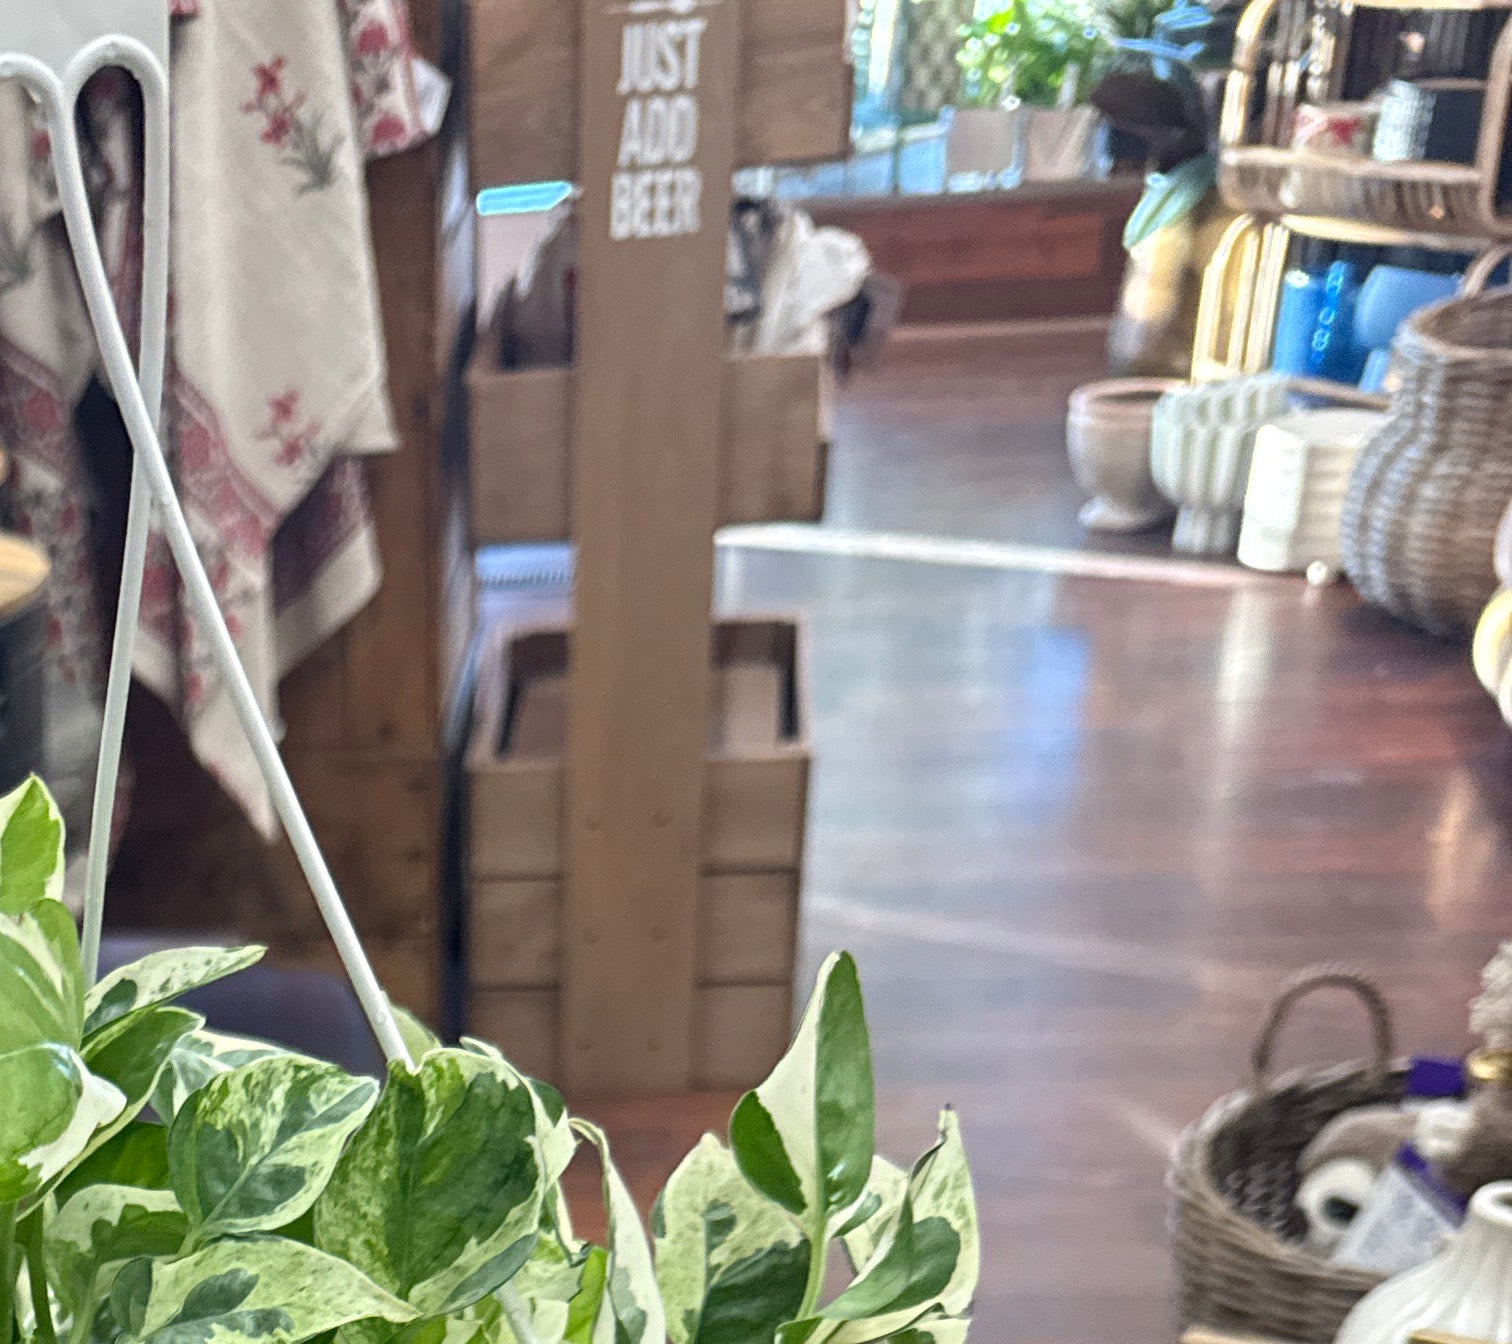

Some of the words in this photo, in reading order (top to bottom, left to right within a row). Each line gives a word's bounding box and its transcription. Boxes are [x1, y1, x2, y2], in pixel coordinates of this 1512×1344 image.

[616, 18, 708, 95] JUST
[617, 94, 699, 168] ADD
[609, 166, 702, 241] BEER
